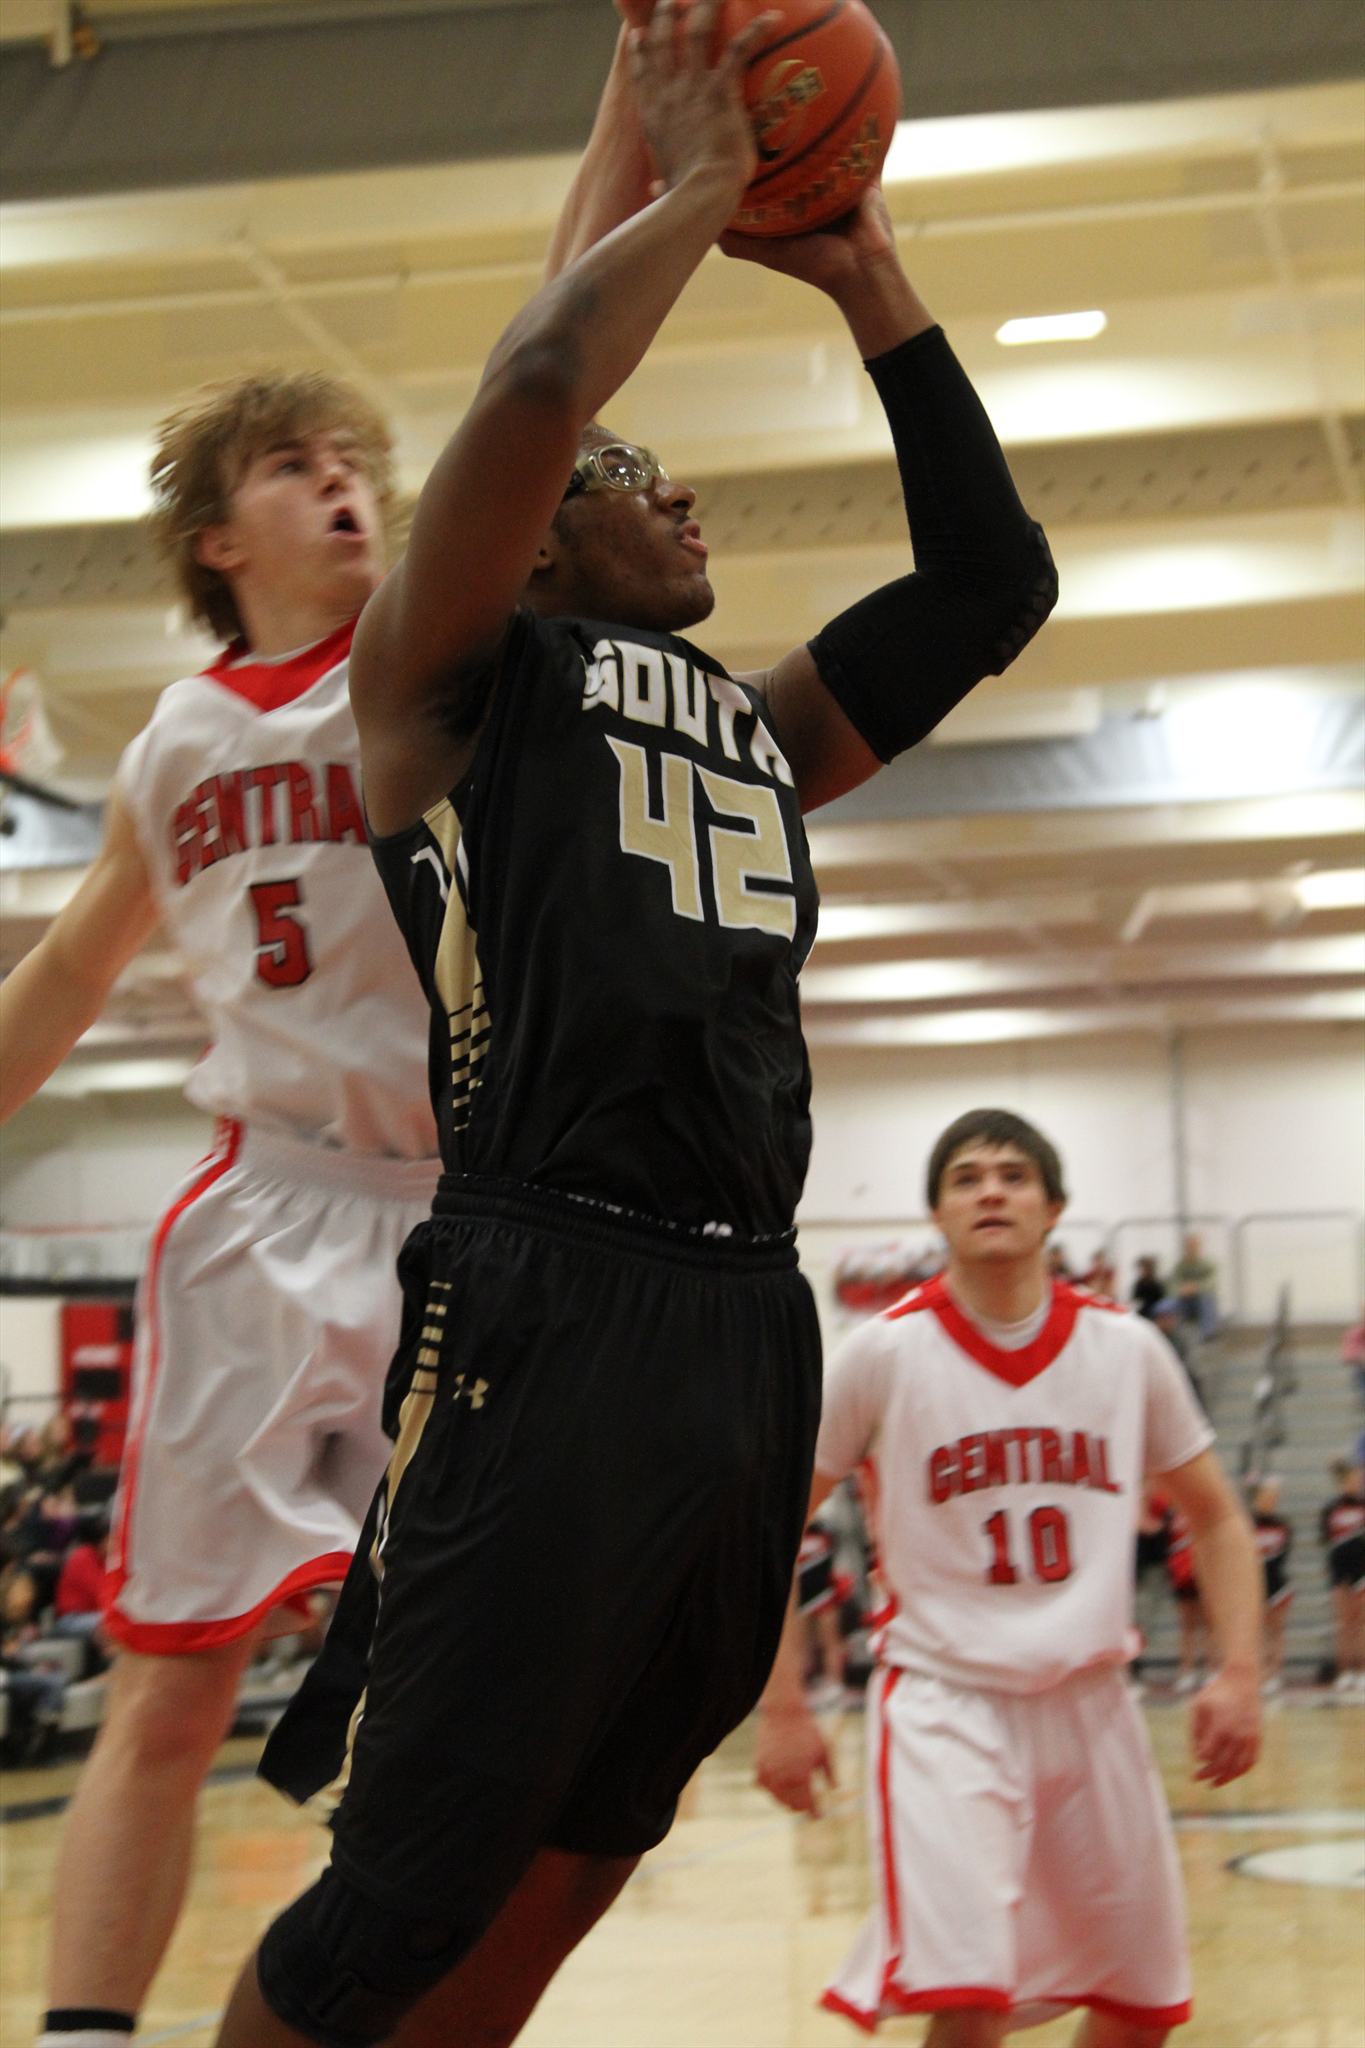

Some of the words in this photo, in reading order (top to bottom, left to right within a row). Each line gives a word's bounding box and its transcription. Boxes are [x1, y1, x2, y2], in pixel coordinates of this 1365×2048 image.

[172, 761, 370, 888] CENTRA
[604, 733, 797, 943] 42
[249, 878, 313, 989] 5
[928, 1426, 1122, 1505] CENTRAL
[984, 1505, 1071, 1585] 10
